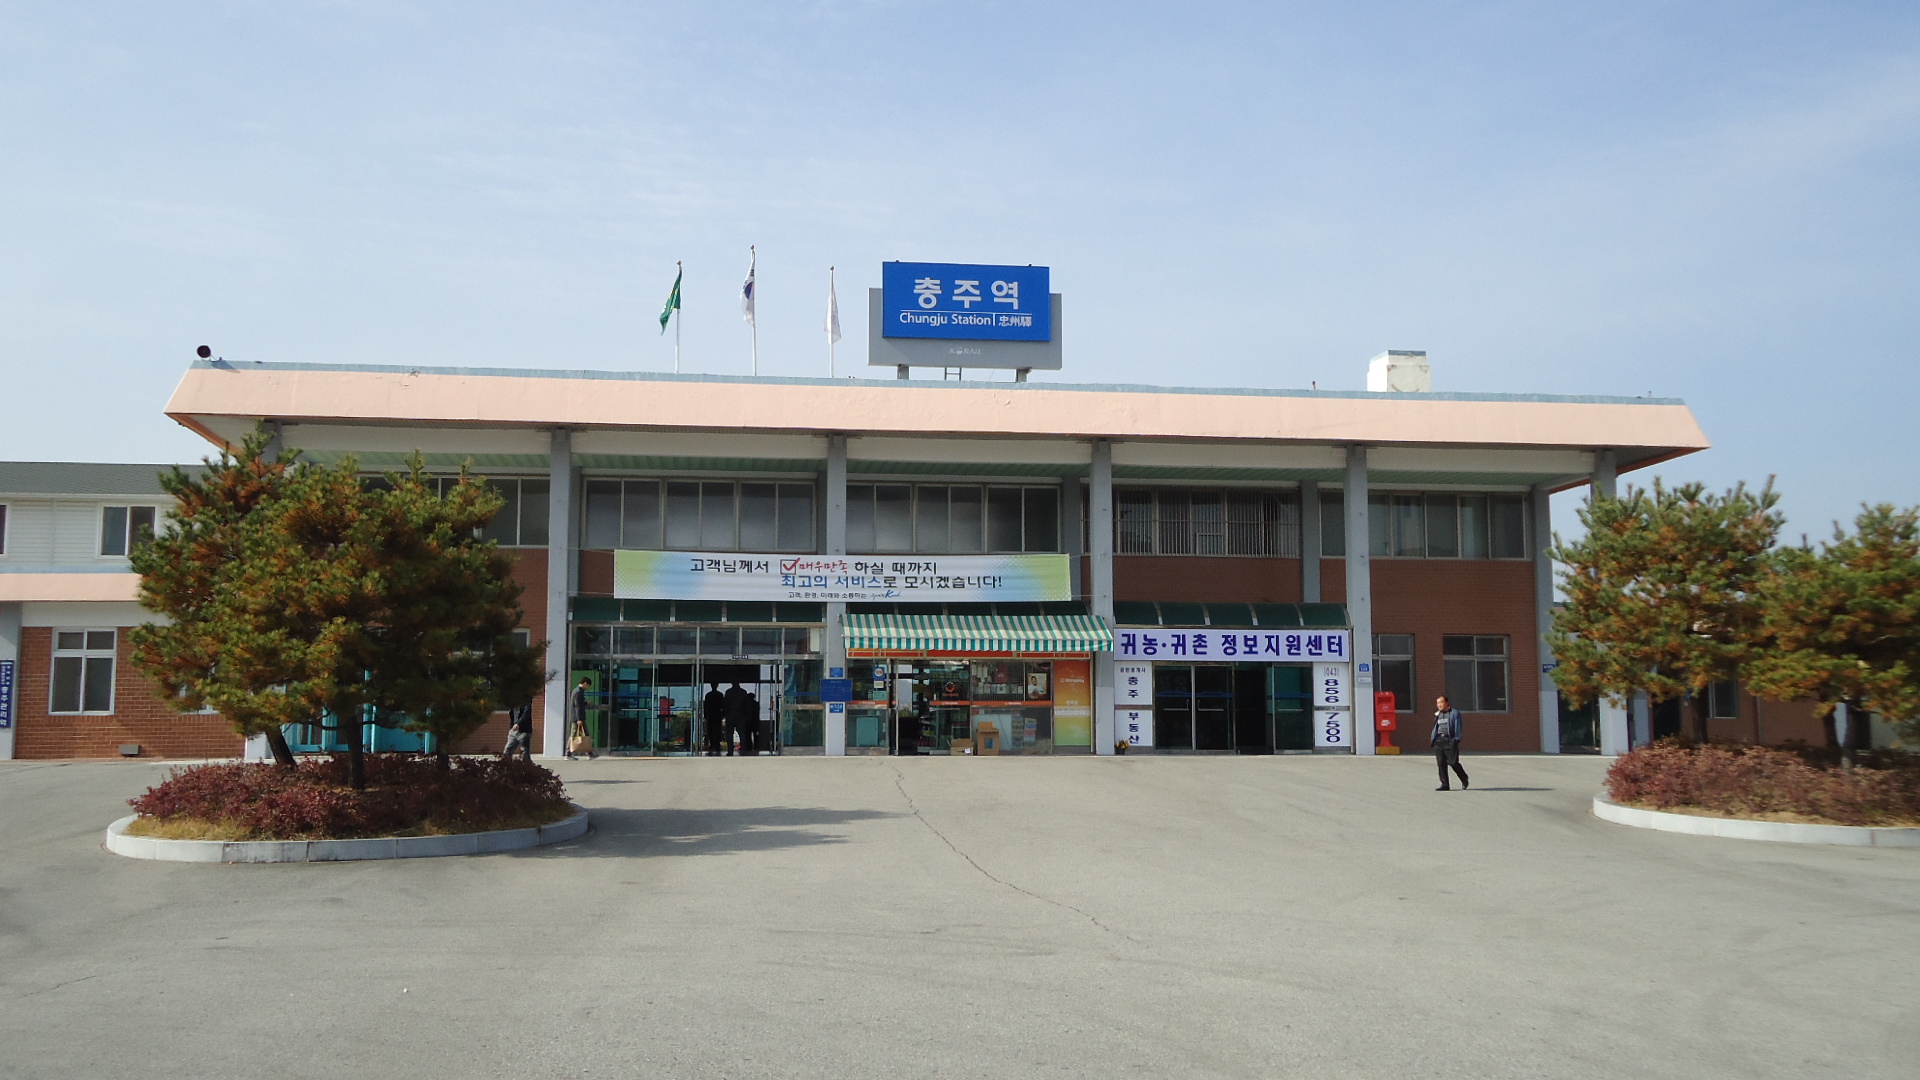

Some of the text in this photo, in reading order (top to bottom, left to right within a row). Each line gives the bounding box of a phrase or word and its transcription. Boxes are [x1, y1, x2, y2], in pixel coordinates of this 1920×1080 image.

[913, 277, 1019, 310] 충주역
[899, 312, 991, 327] Chungju Station
[690, 558, 937, 575] 고객님께서 매우만족 하실 때까지
[781, 574, 1003, 589] 최고의 서비스로 모시겠습니다!
[1120, 633, 1343, 657] 귀농·귀촌 정보지원센터
[1323, 667, 1340, 677] (043)
[1127, 676, 1139, 699] 충주
[1128, 712, 1140, 744] 부동산
